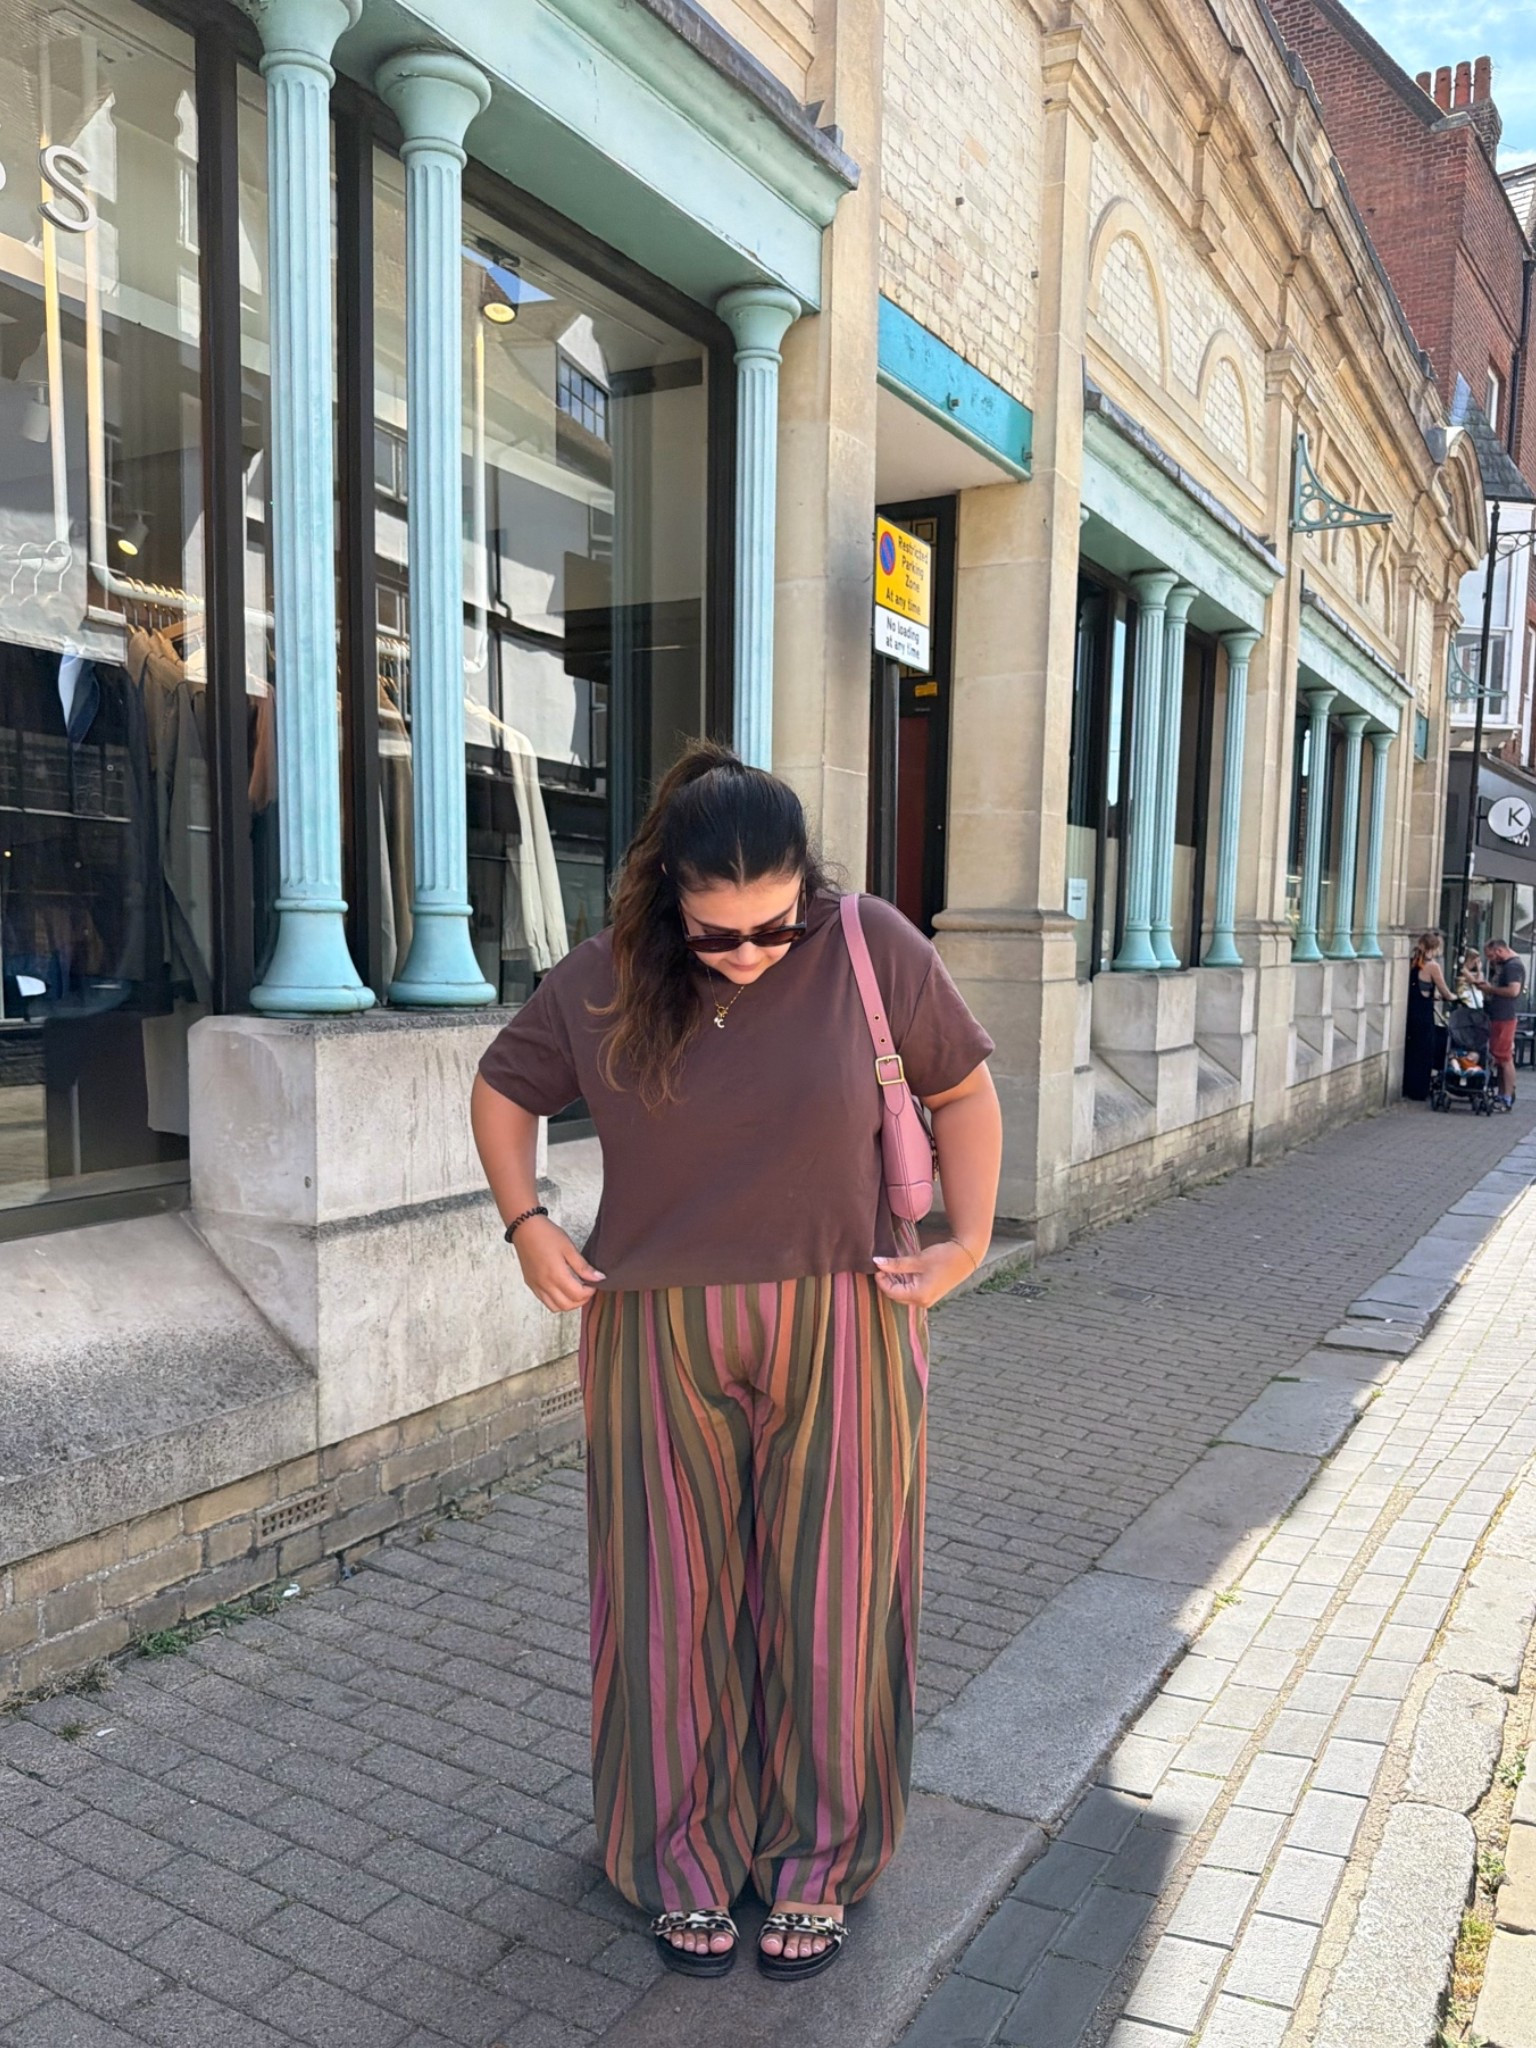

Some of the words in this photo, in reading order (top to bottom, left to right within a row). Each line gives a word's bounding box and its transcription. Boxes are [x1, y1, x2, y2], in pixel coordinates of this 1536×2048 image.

[0, 144, 98, 234] S
[898, 536, 929, 564] Restricted
[902, 555, 924, 581] Parking
[905, 574, 920, 593] Zone
[886, 587, 894, 602] At
[895, 594, 906, 611] any
[908, 598, 921, 615] time
[886, 616, 896, 632] No
[897, 620, 920, 645] loading
[885, 634, 893, 648] at
[894, 640, 905, 655] any
[907, 642, 920, 660] time
[1508, 807, 1525, 827] K
